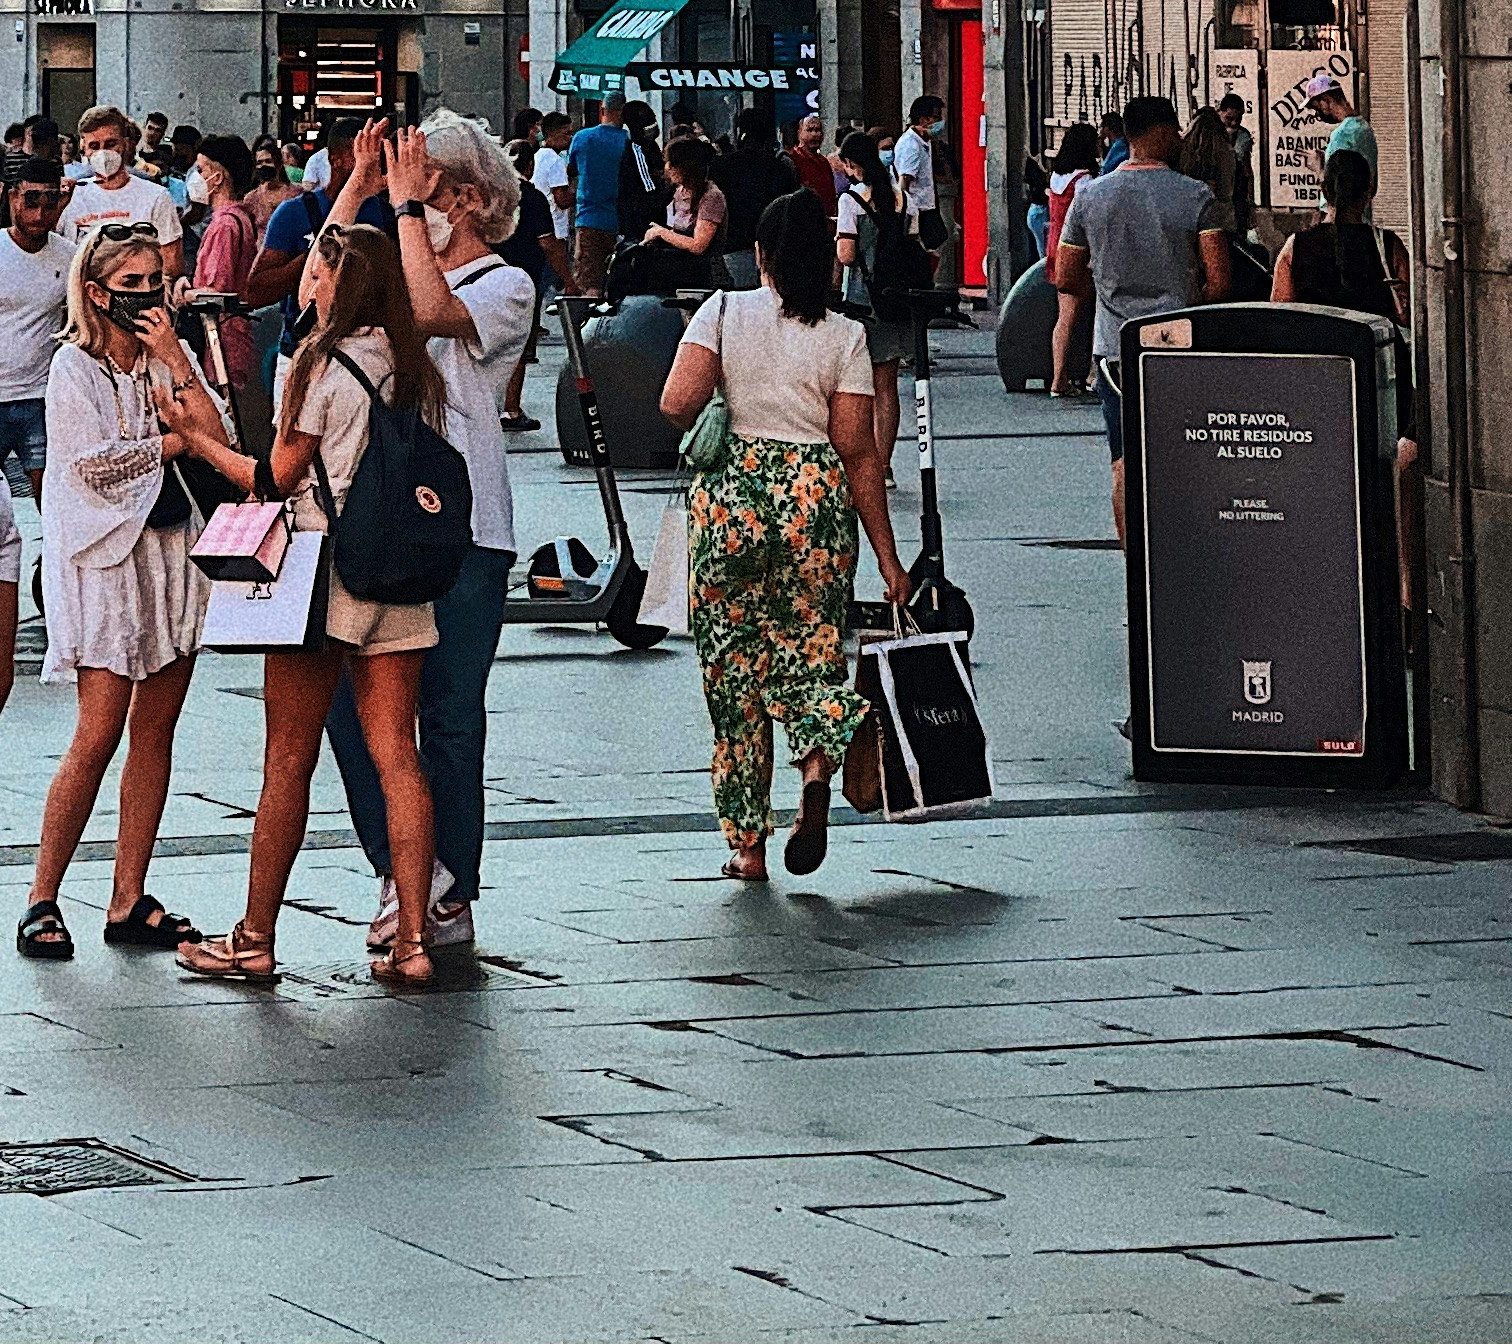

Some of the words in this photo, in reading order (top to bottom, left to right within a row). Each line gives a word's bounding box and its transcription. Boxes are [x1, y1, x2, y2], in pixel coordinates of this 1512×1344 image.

[650, 68, 789, 89] CHANGE
[1276, 136, 1329, 151] ABANIC
[1279, 174, 1321, 186] FUND
[1207, 412, 1238, 425] POR
[1240, 413, 1290, 428] FAVOR,
[1185, 428, 1208, 441] NO
[1210, 429, 1241, 442] TIRE
[1243, 430, 1313, 443] RESIDUOS
[1217, 445, 1236, 458] AL
[1237, 446, 1282, 459] SUELO
[1218, 510, 1235, 520] NO
[1236, 511, 1285, 521] LITTERING
[1232, 710, 1284, 723] MADRID
